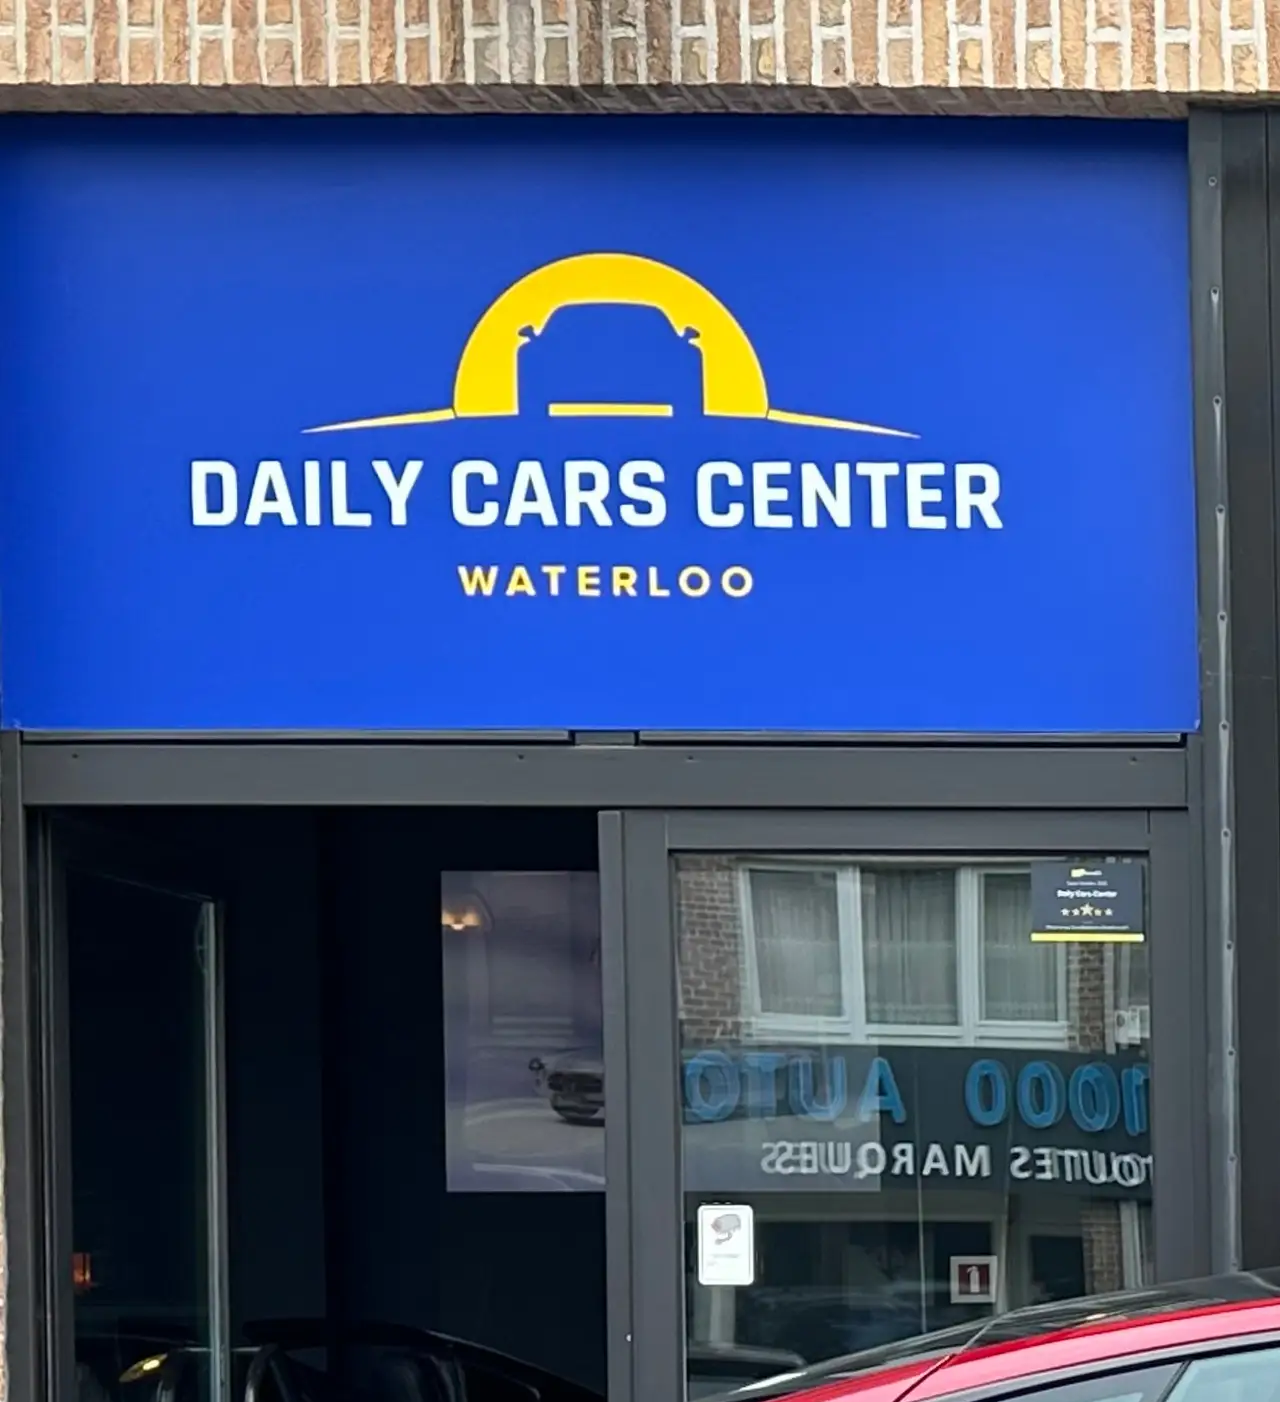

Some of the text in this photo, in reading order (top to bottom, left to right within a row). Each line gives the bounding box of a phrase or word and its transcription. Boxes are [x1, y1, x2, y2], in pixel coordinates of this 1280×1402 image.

[192, 460, 1003, 530] DAILY CARS CENTER
[458, 565, 754, 598] WATERLOO
